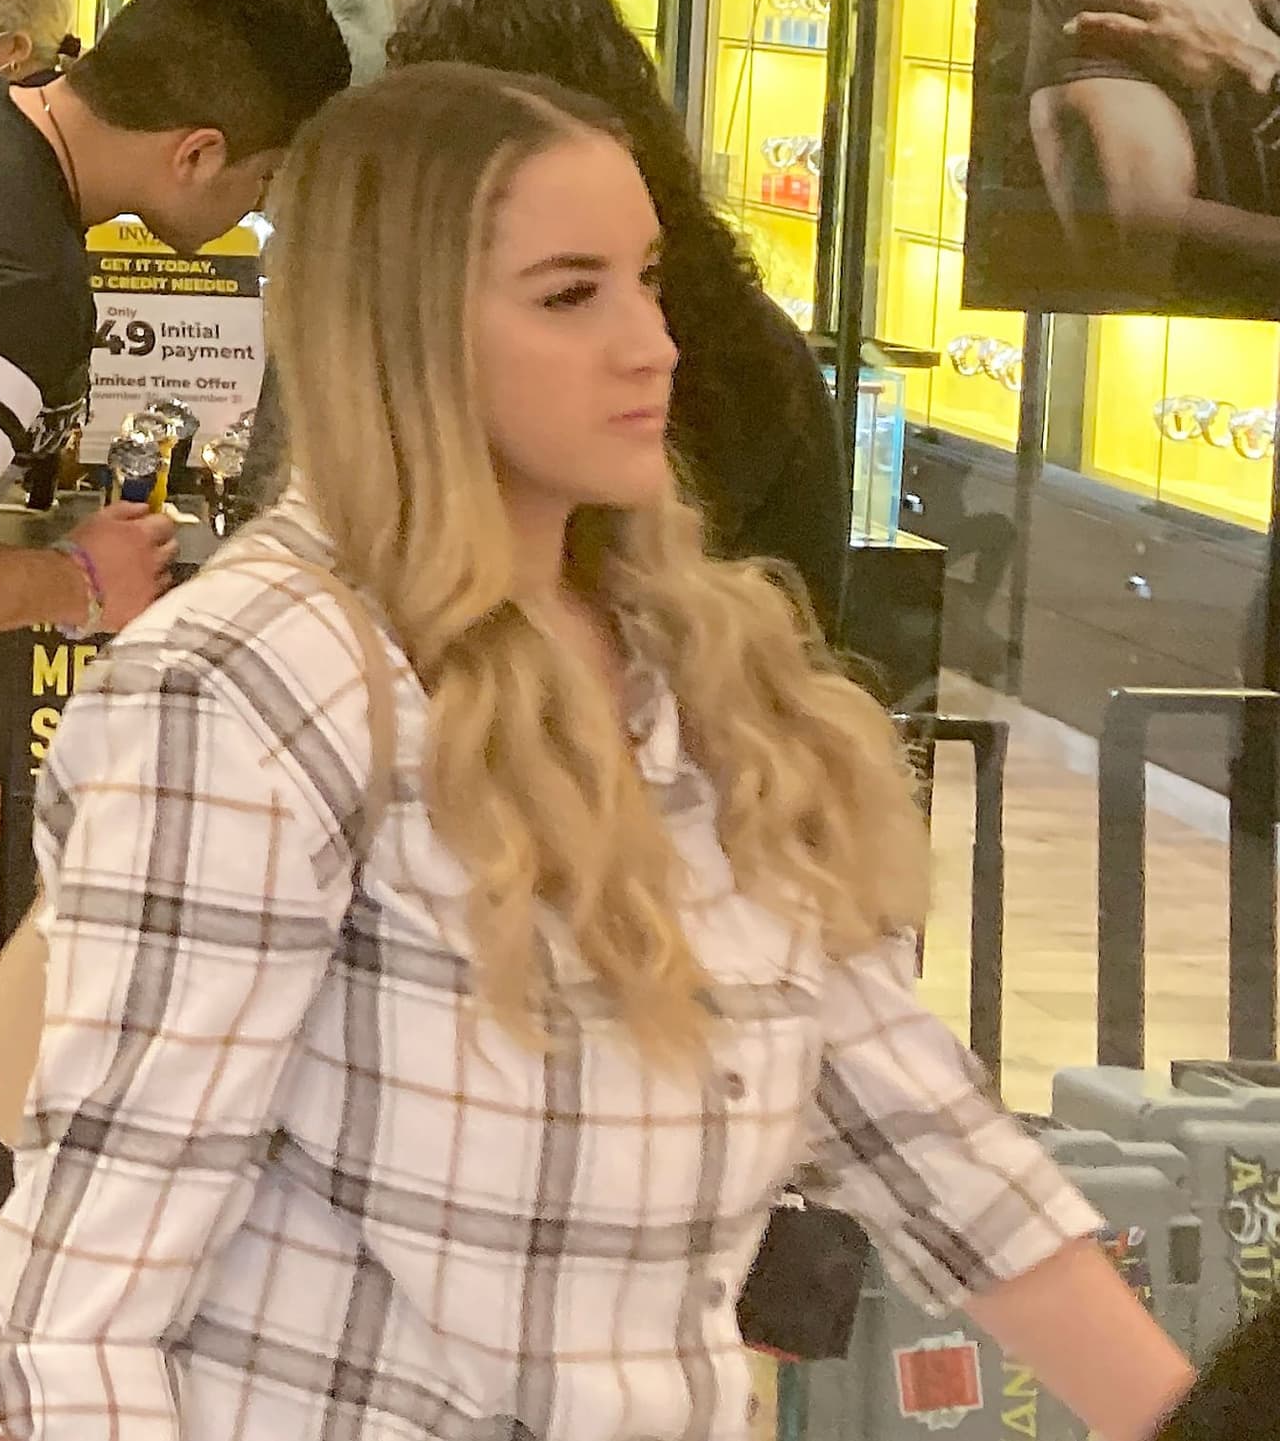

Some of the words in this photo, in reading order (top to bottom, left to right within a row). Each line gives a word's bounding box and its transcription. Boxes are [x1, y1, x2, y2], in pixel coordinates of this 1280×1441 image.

[100, 257, 132, 272] GET
[135, 258, 152, 272] IT
[154, 260, 217, 276] TODAY,
[107, 275, 169, 291] CREDIT
[171, 278, 239, 293] NEEDED
[107, 306, 138, 320] Only
[160, 321, 220, 339] Initial
[161, 344, 256, 362] payment
[92, 372, 146, 388] imited
[151, 375, 191, 389] Time
[195, 376, 238, 391] Offer
